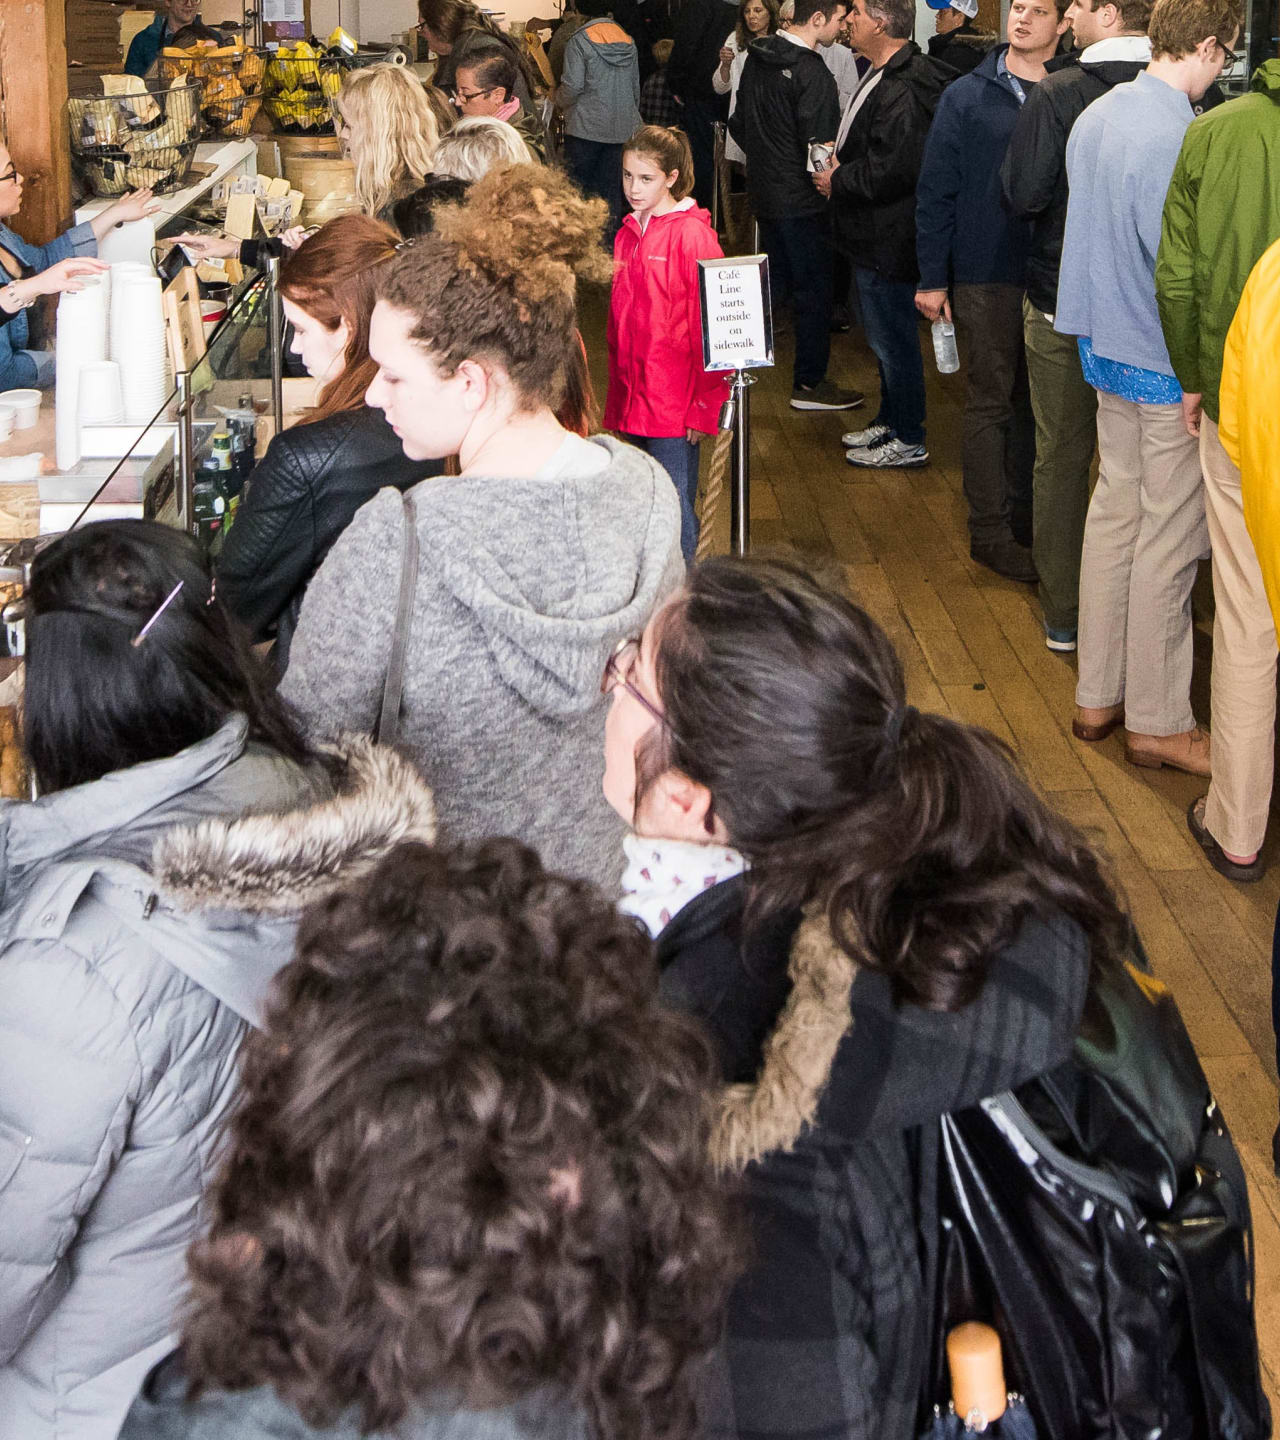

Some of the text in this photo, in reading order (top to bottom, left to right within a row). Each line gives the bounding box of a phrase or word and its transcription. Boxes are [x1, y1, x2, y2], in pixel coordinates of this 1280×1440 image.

[718, 269, 741, 280] Café
[720, 284, 742, 294] Line
[720, 299, 745, 307] starts
[716, 311, 751, 322] outside
[729, 327, 742, 335] on
[714, 338, 754, 350] sidewalk
